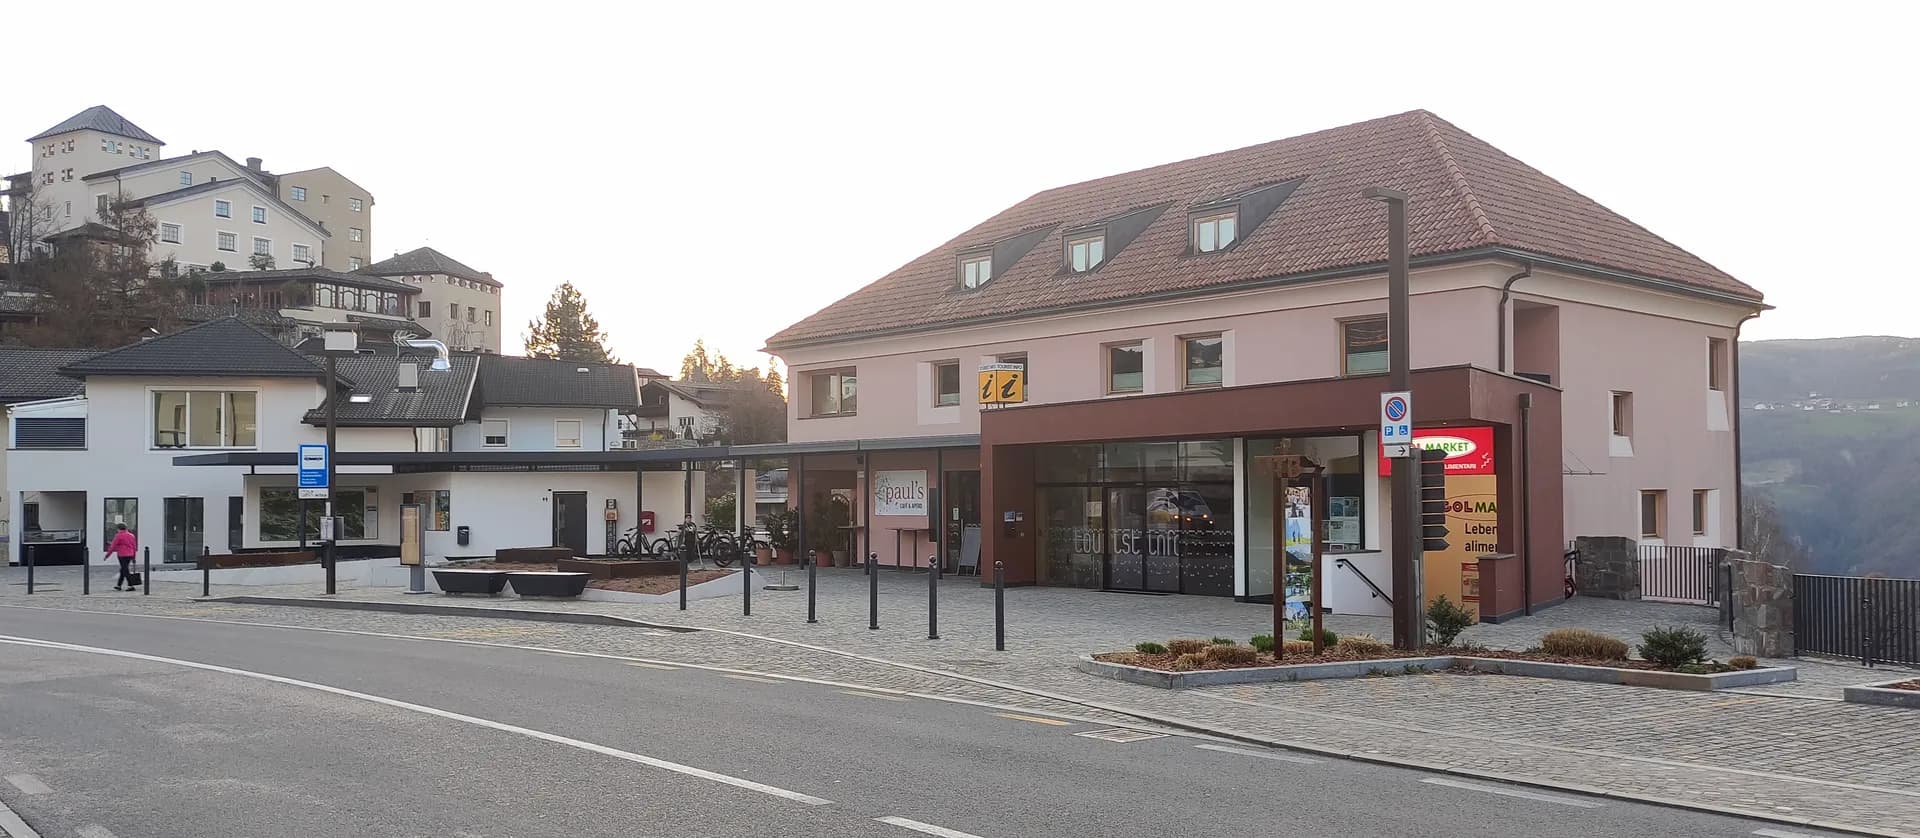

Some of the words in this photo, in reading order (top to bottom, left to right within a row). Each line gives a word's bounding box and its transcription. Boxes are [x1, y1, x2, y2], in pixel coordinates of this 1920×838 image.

[1386, 427, 1392, 435] P
[1425, 442, 1469, 452] MARKET
[885, 480, 924, 505] paul's
[1073, 528, 1141, 554] touist
